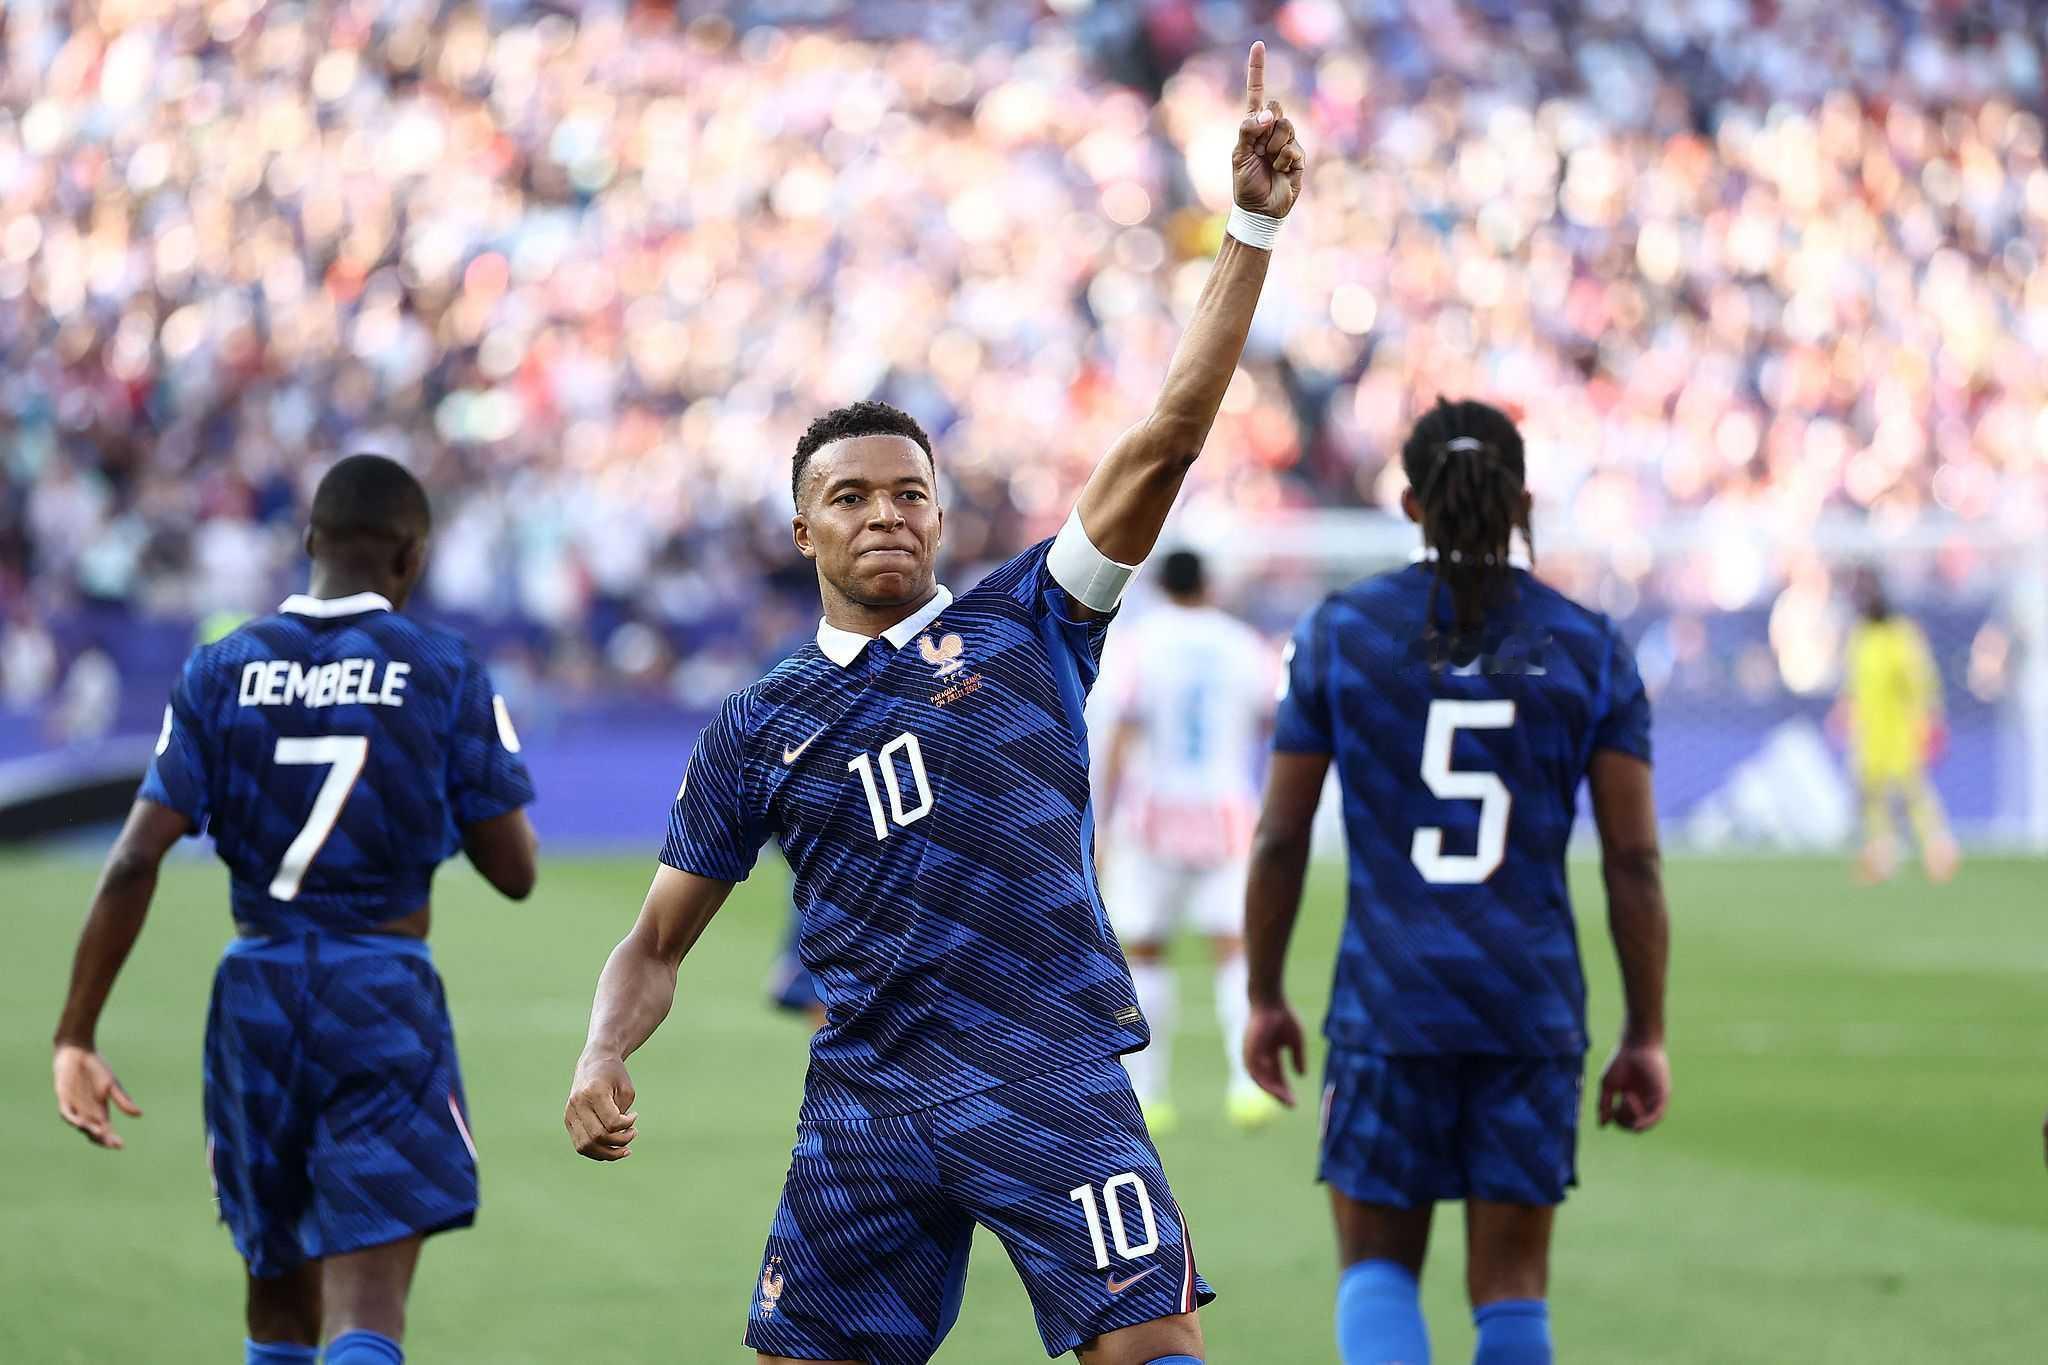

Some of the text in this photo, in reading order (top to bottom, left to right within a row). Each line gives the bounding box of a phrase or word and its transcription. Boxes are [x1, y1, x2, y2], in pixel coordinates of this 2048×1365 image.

[238, 658, 411, 708] DEMBELE
[269, 735, 369, 901] 7
[847, 731, 935, 842] 10
[1411, 699, 1516, 884] 5
[1069, 1171, 1161, 1270] 10
